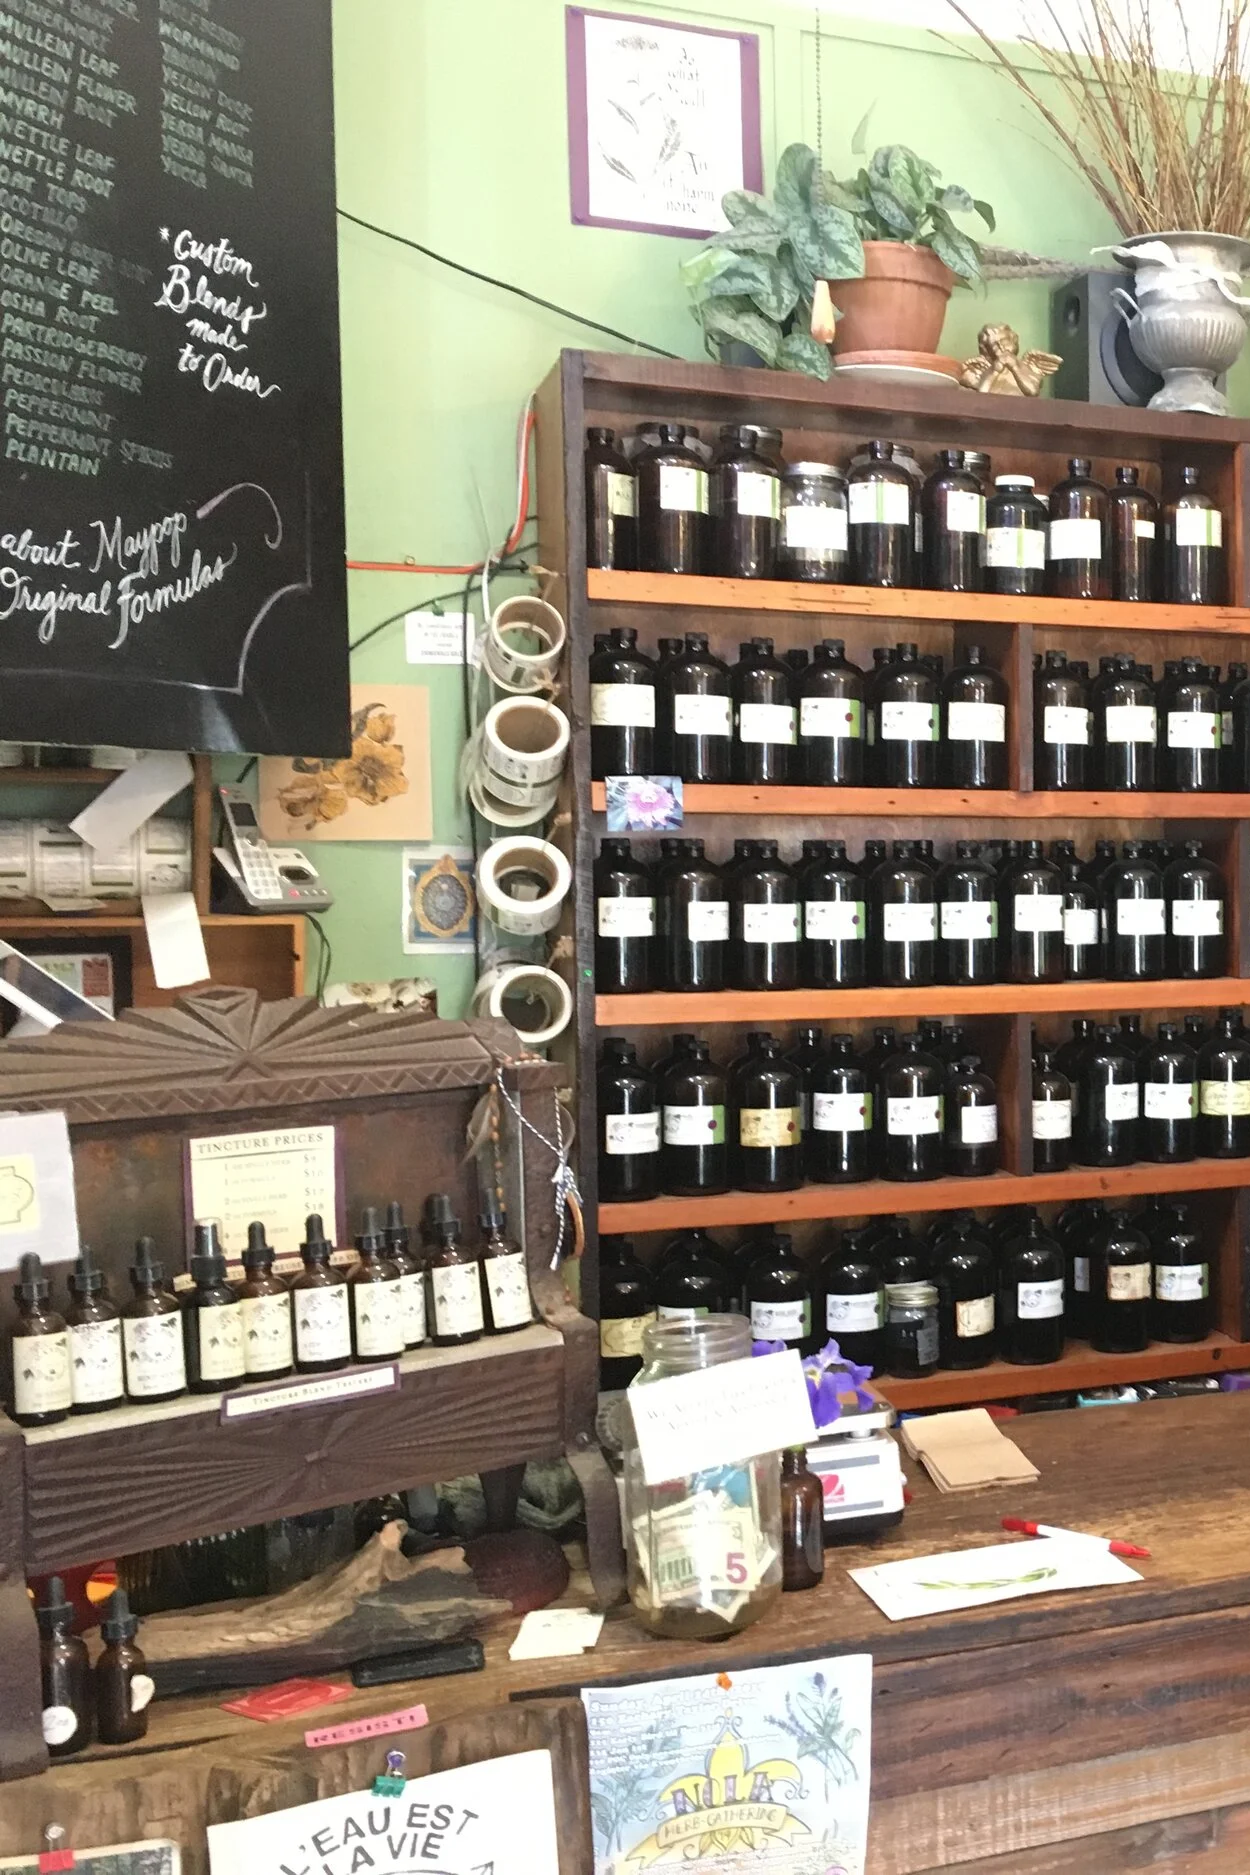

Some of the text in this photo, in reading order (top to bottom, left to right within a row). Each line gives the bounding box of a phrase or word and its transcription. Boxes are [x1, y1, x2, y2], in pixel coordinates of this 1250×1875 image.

[0, 112, 70, 156] NETTLE
[0, 139, 66, 180] NETTLE
[178, 343, 204, 372] to
[1, 512, 187, 578] about Maypop
[196, 1132, 324, 1154] TINCTURE PRICES
[725, 1552, 749, 1585] 5
[671, 1771, 775, 1817] NOLA
[406, 1803, 480, 1835] EST
[386, 1832, 445, 1860] VIE
